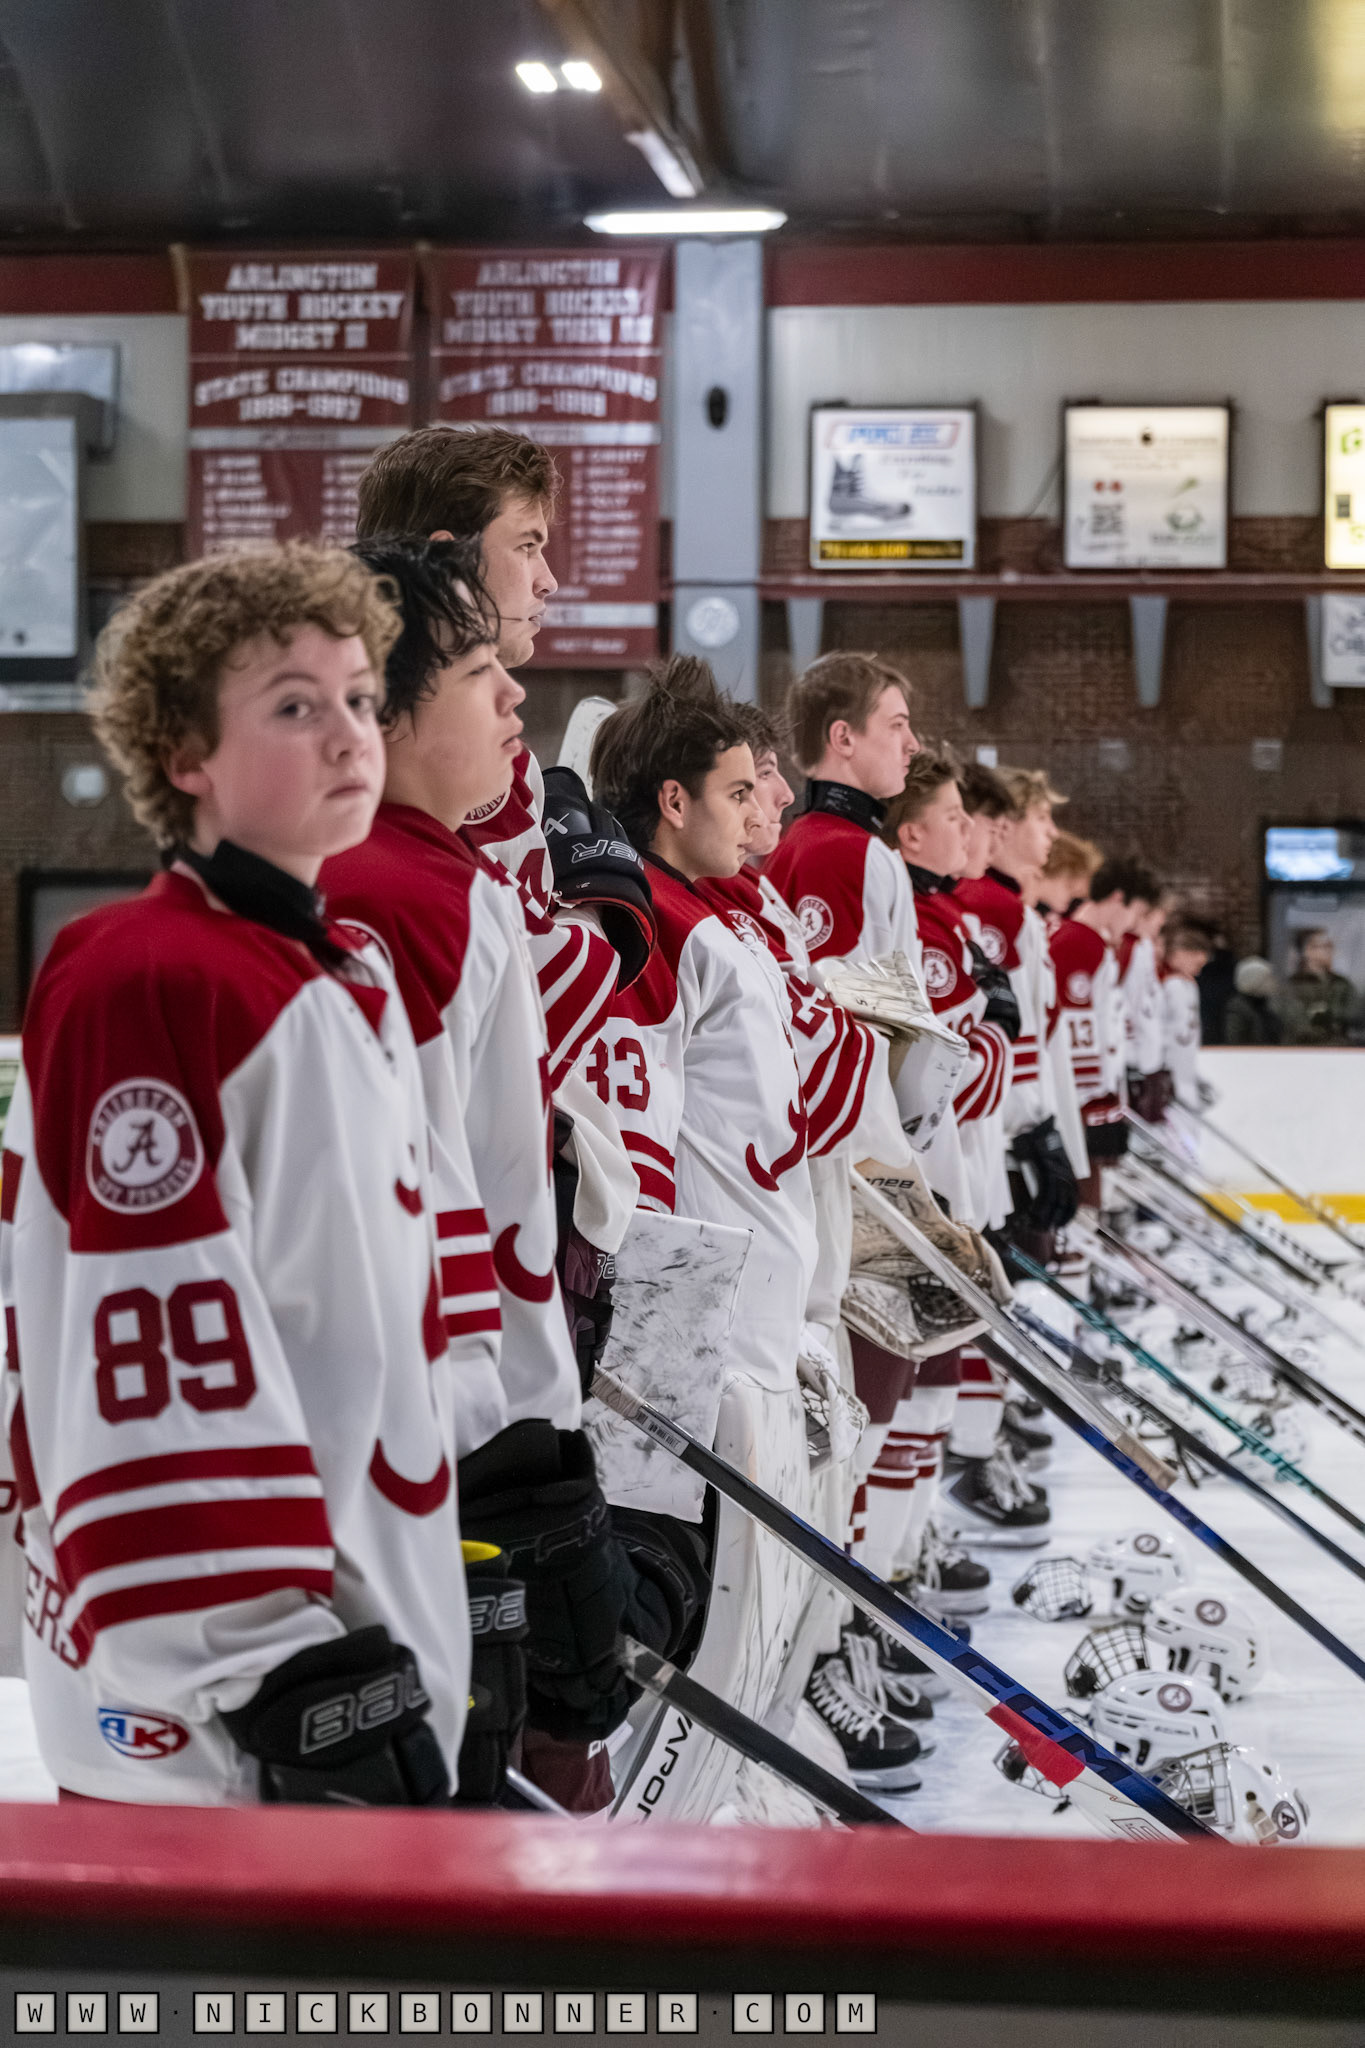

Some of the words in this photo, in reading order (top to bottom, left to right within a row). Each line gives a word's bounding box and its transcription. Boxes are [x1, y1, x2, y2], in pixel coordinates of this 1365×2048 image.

[227, 264, 378, 290] ARLINGTON
[201, 294, 287, 320] YOUTH
[299, 292, 402, 319] HOCKEY
[1068, 1018, 1093, 1048] 13
[585, 1036, 651, 1113] 33
[93, 1278, 258, 1425] 89
[951, 1651, 1133, 1784] CCM
